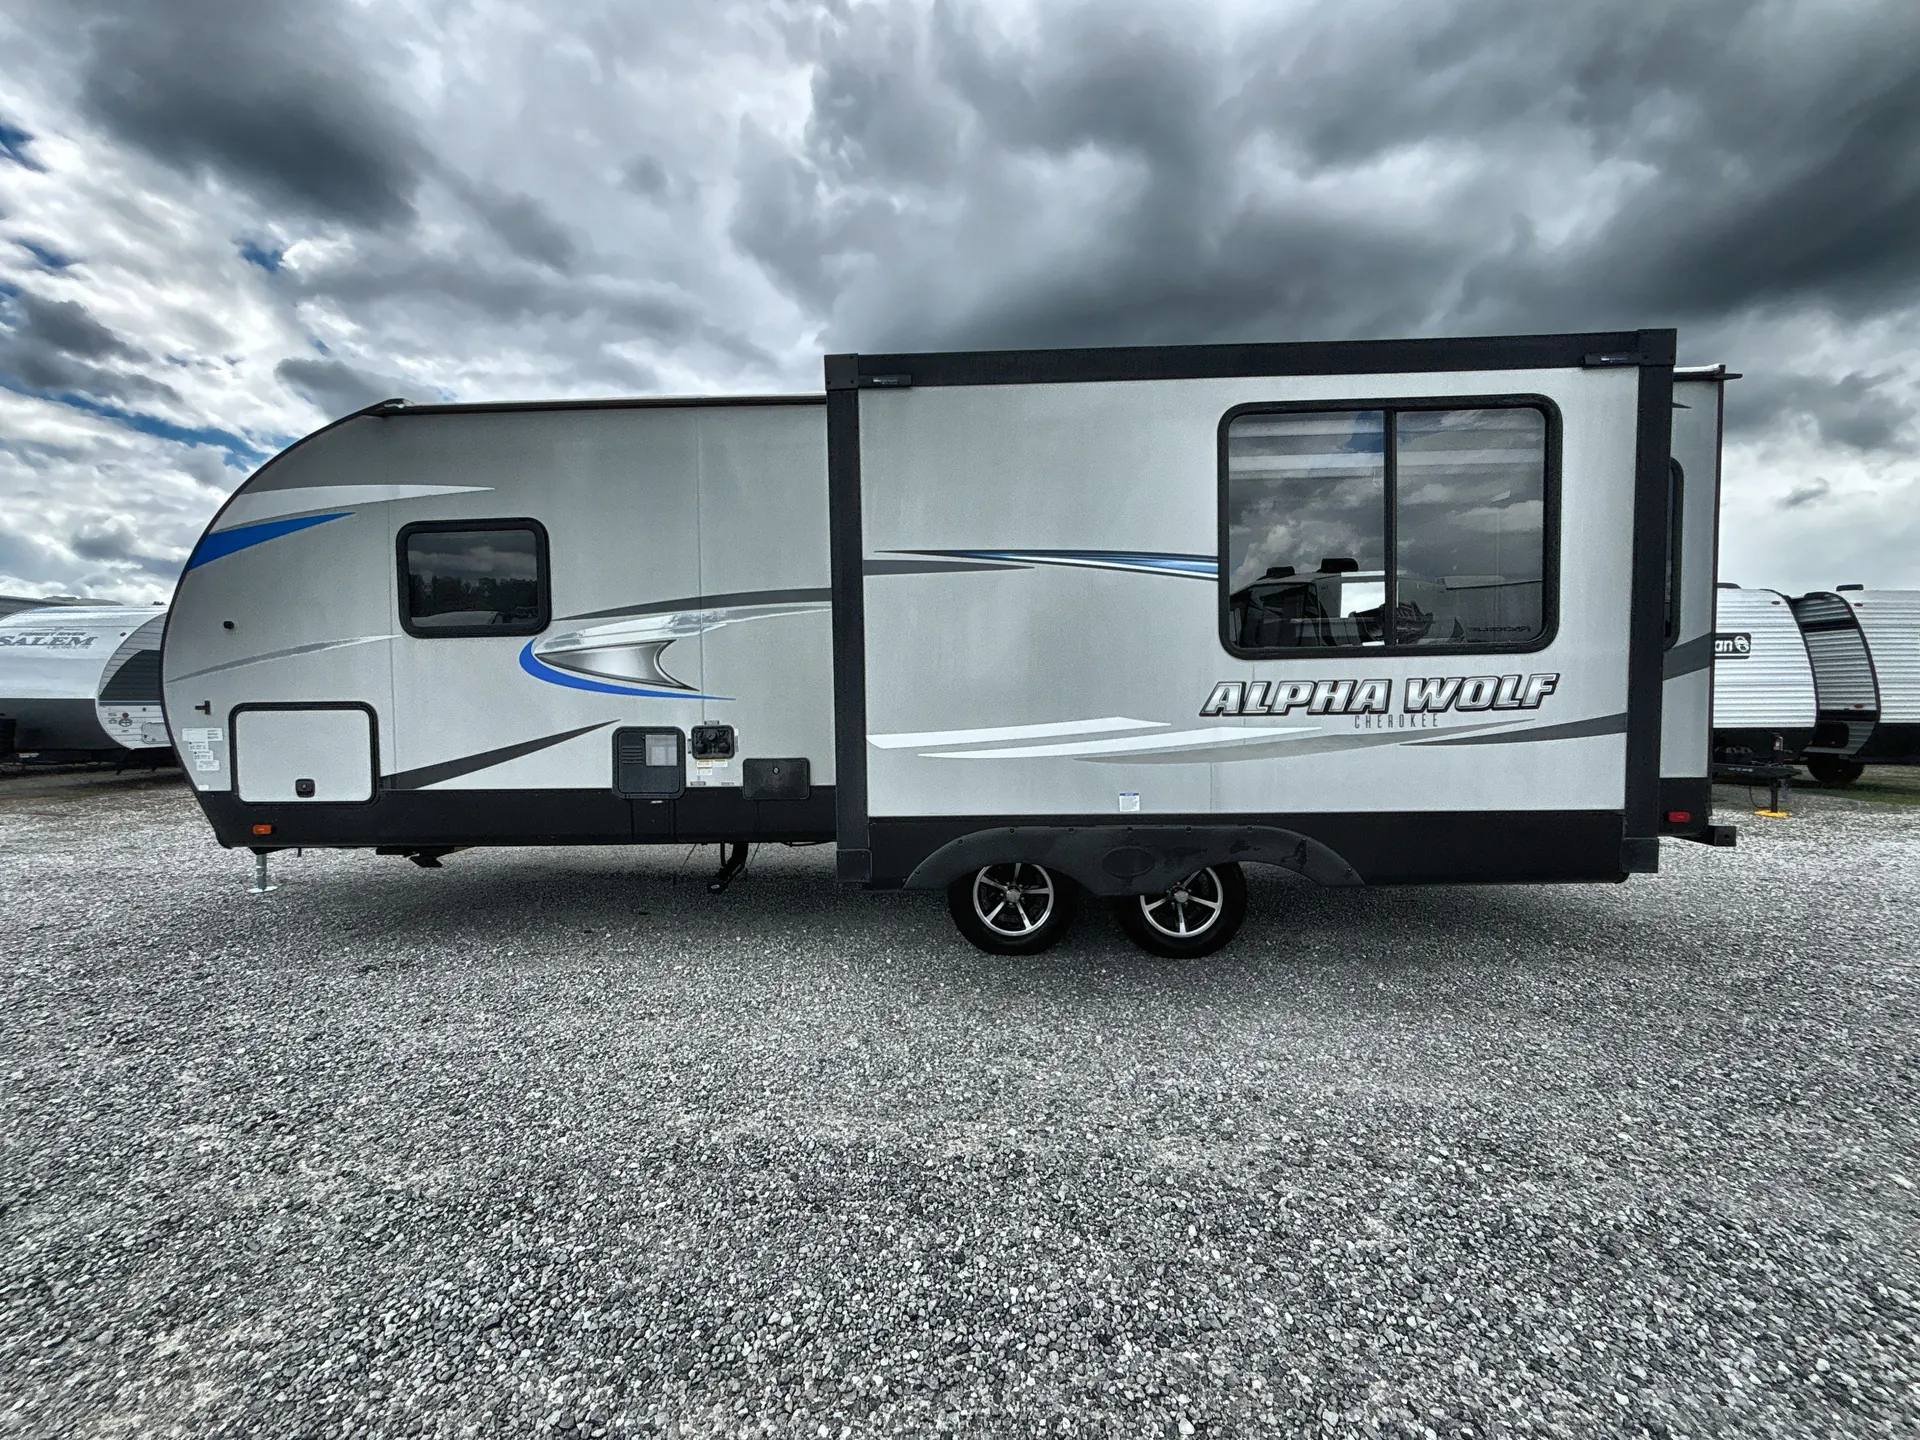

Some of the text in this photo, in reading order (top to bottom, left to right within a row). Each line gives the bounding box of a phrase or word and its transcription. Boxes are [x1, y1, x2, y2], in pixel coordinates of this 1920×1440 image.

[0, 635, 99, 646] SALEM
[1199, 673, 1560, 716] ALPHA WOLF
[1354, 713, 1438, 729] CHEROKEE
